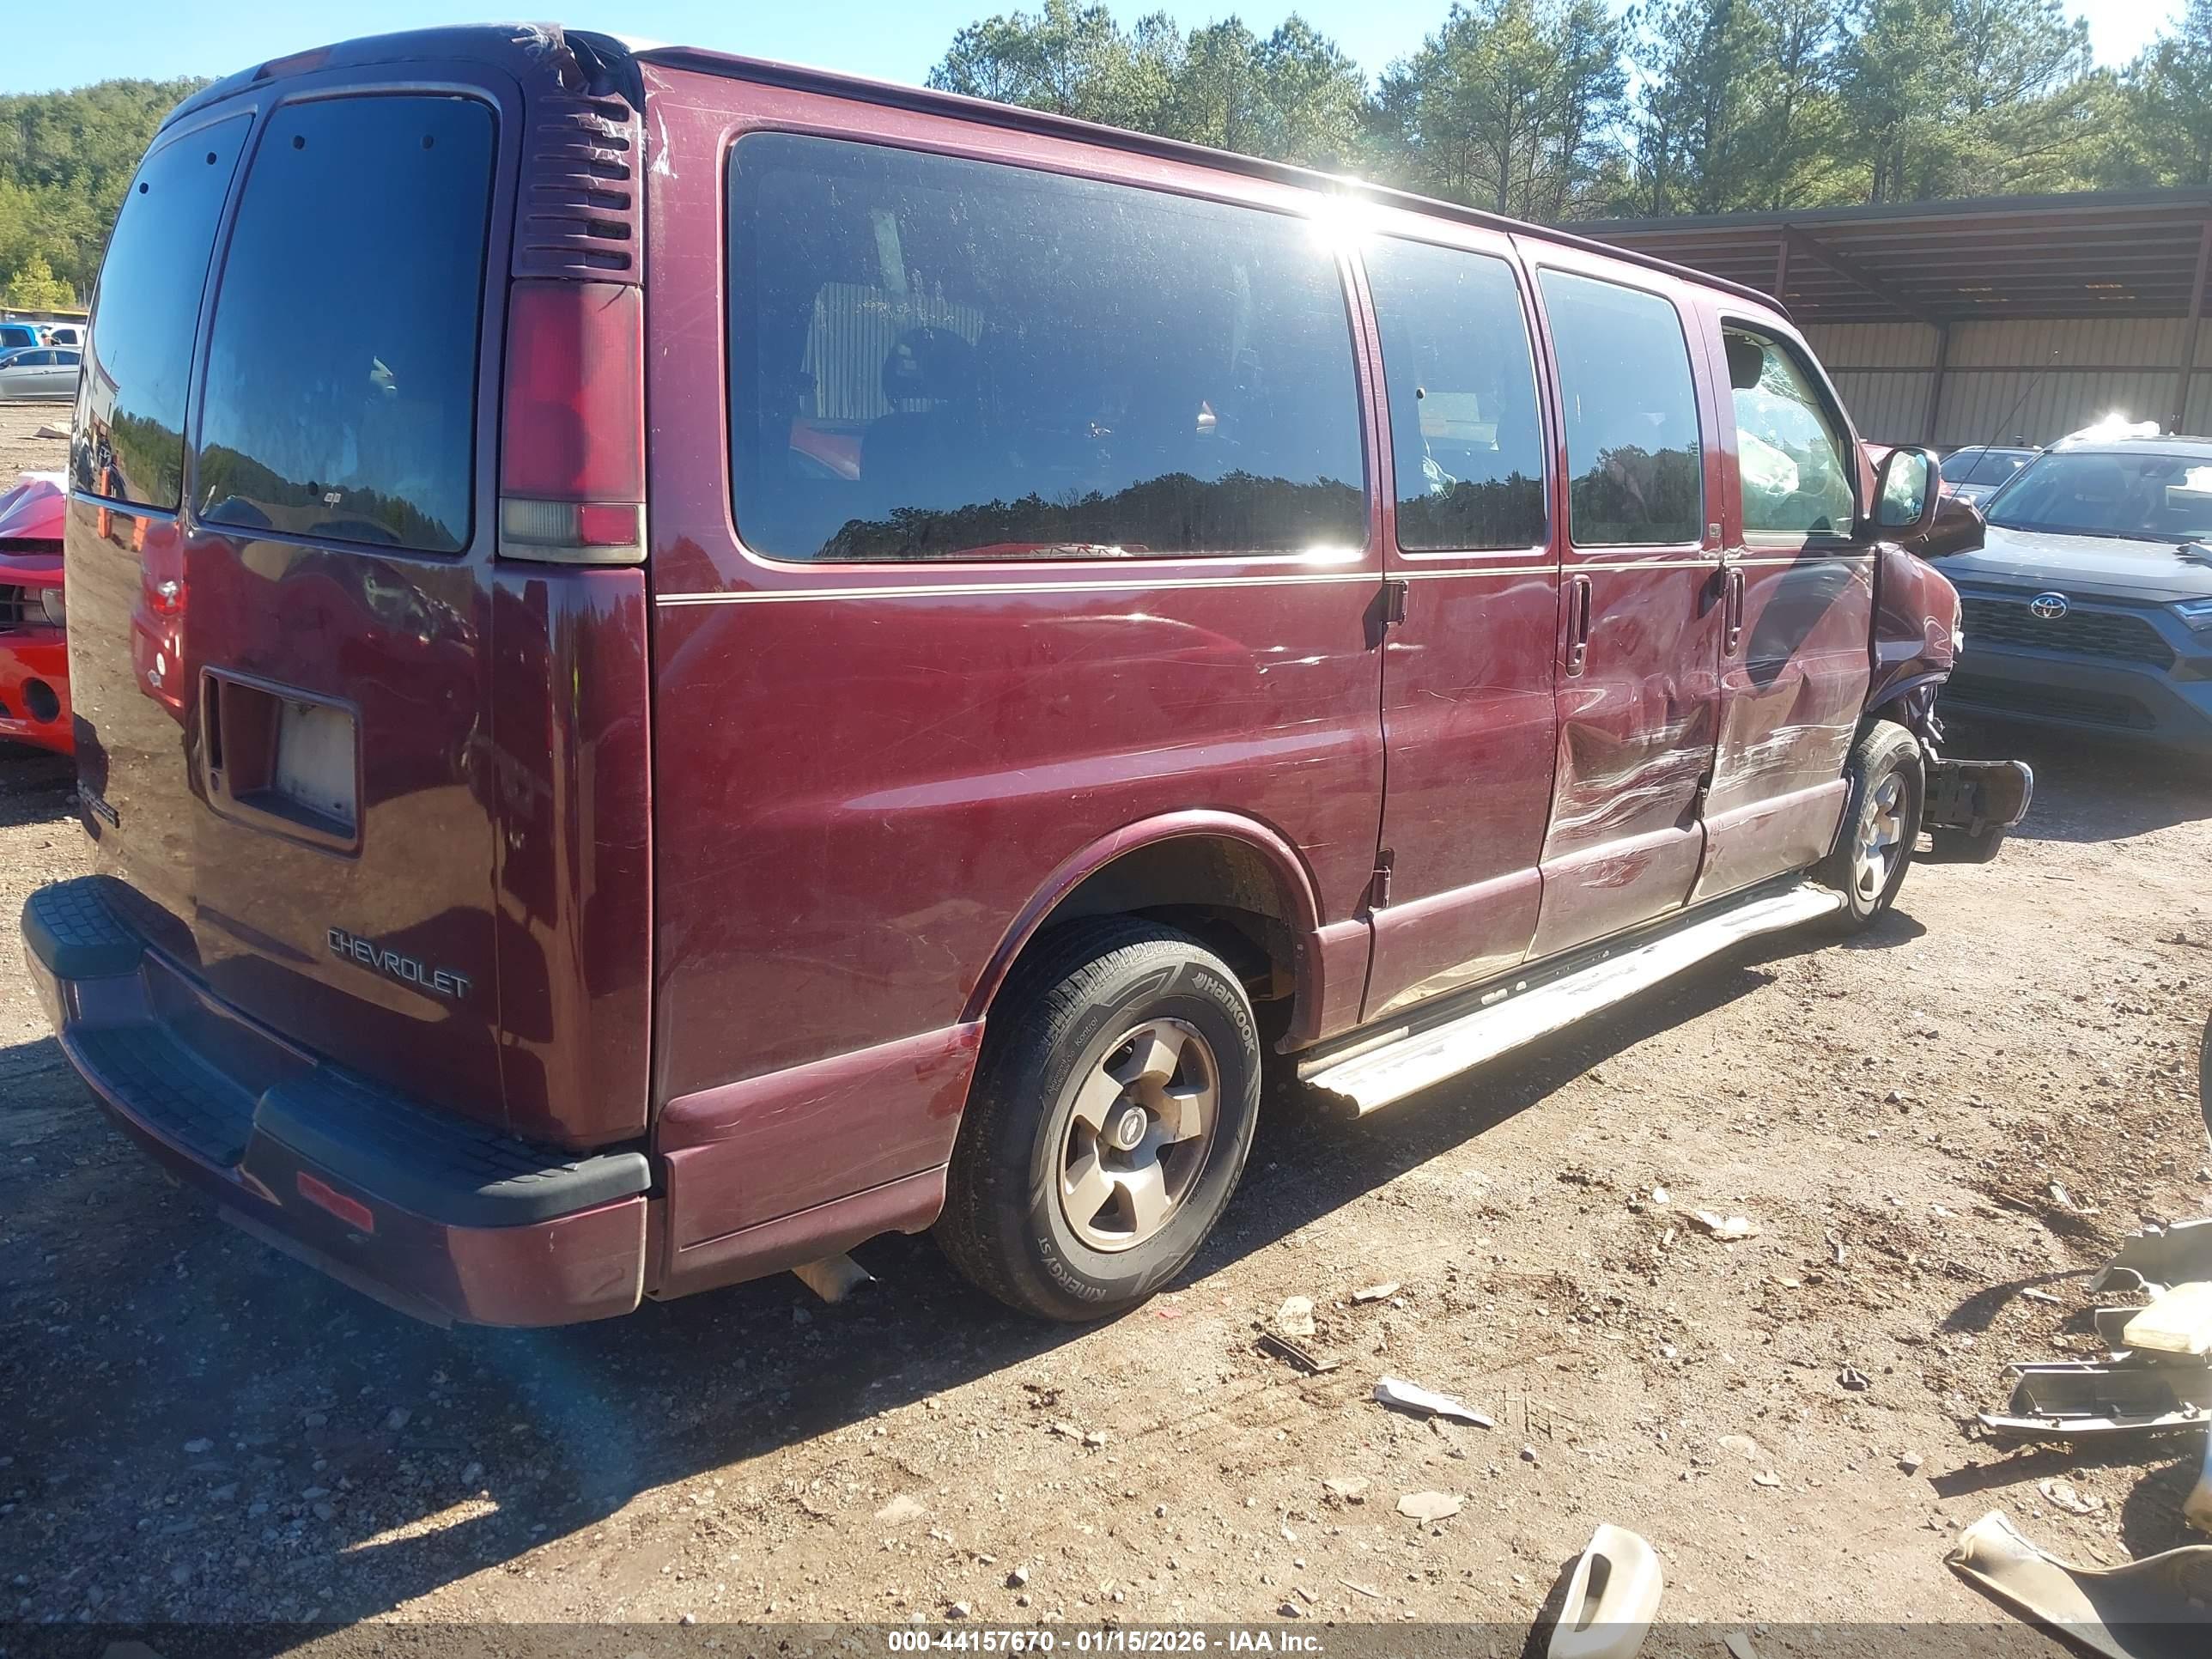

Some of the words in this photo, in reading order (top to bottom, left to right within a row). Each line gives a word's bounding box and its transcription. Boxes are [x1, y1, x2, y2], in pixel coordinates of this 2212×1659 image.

[326, 927, 469, 999] CHEVROLET
[1073, 1016, 1099, 1047] Kontrol
[1037, 1237, 1052, 1255] ST
